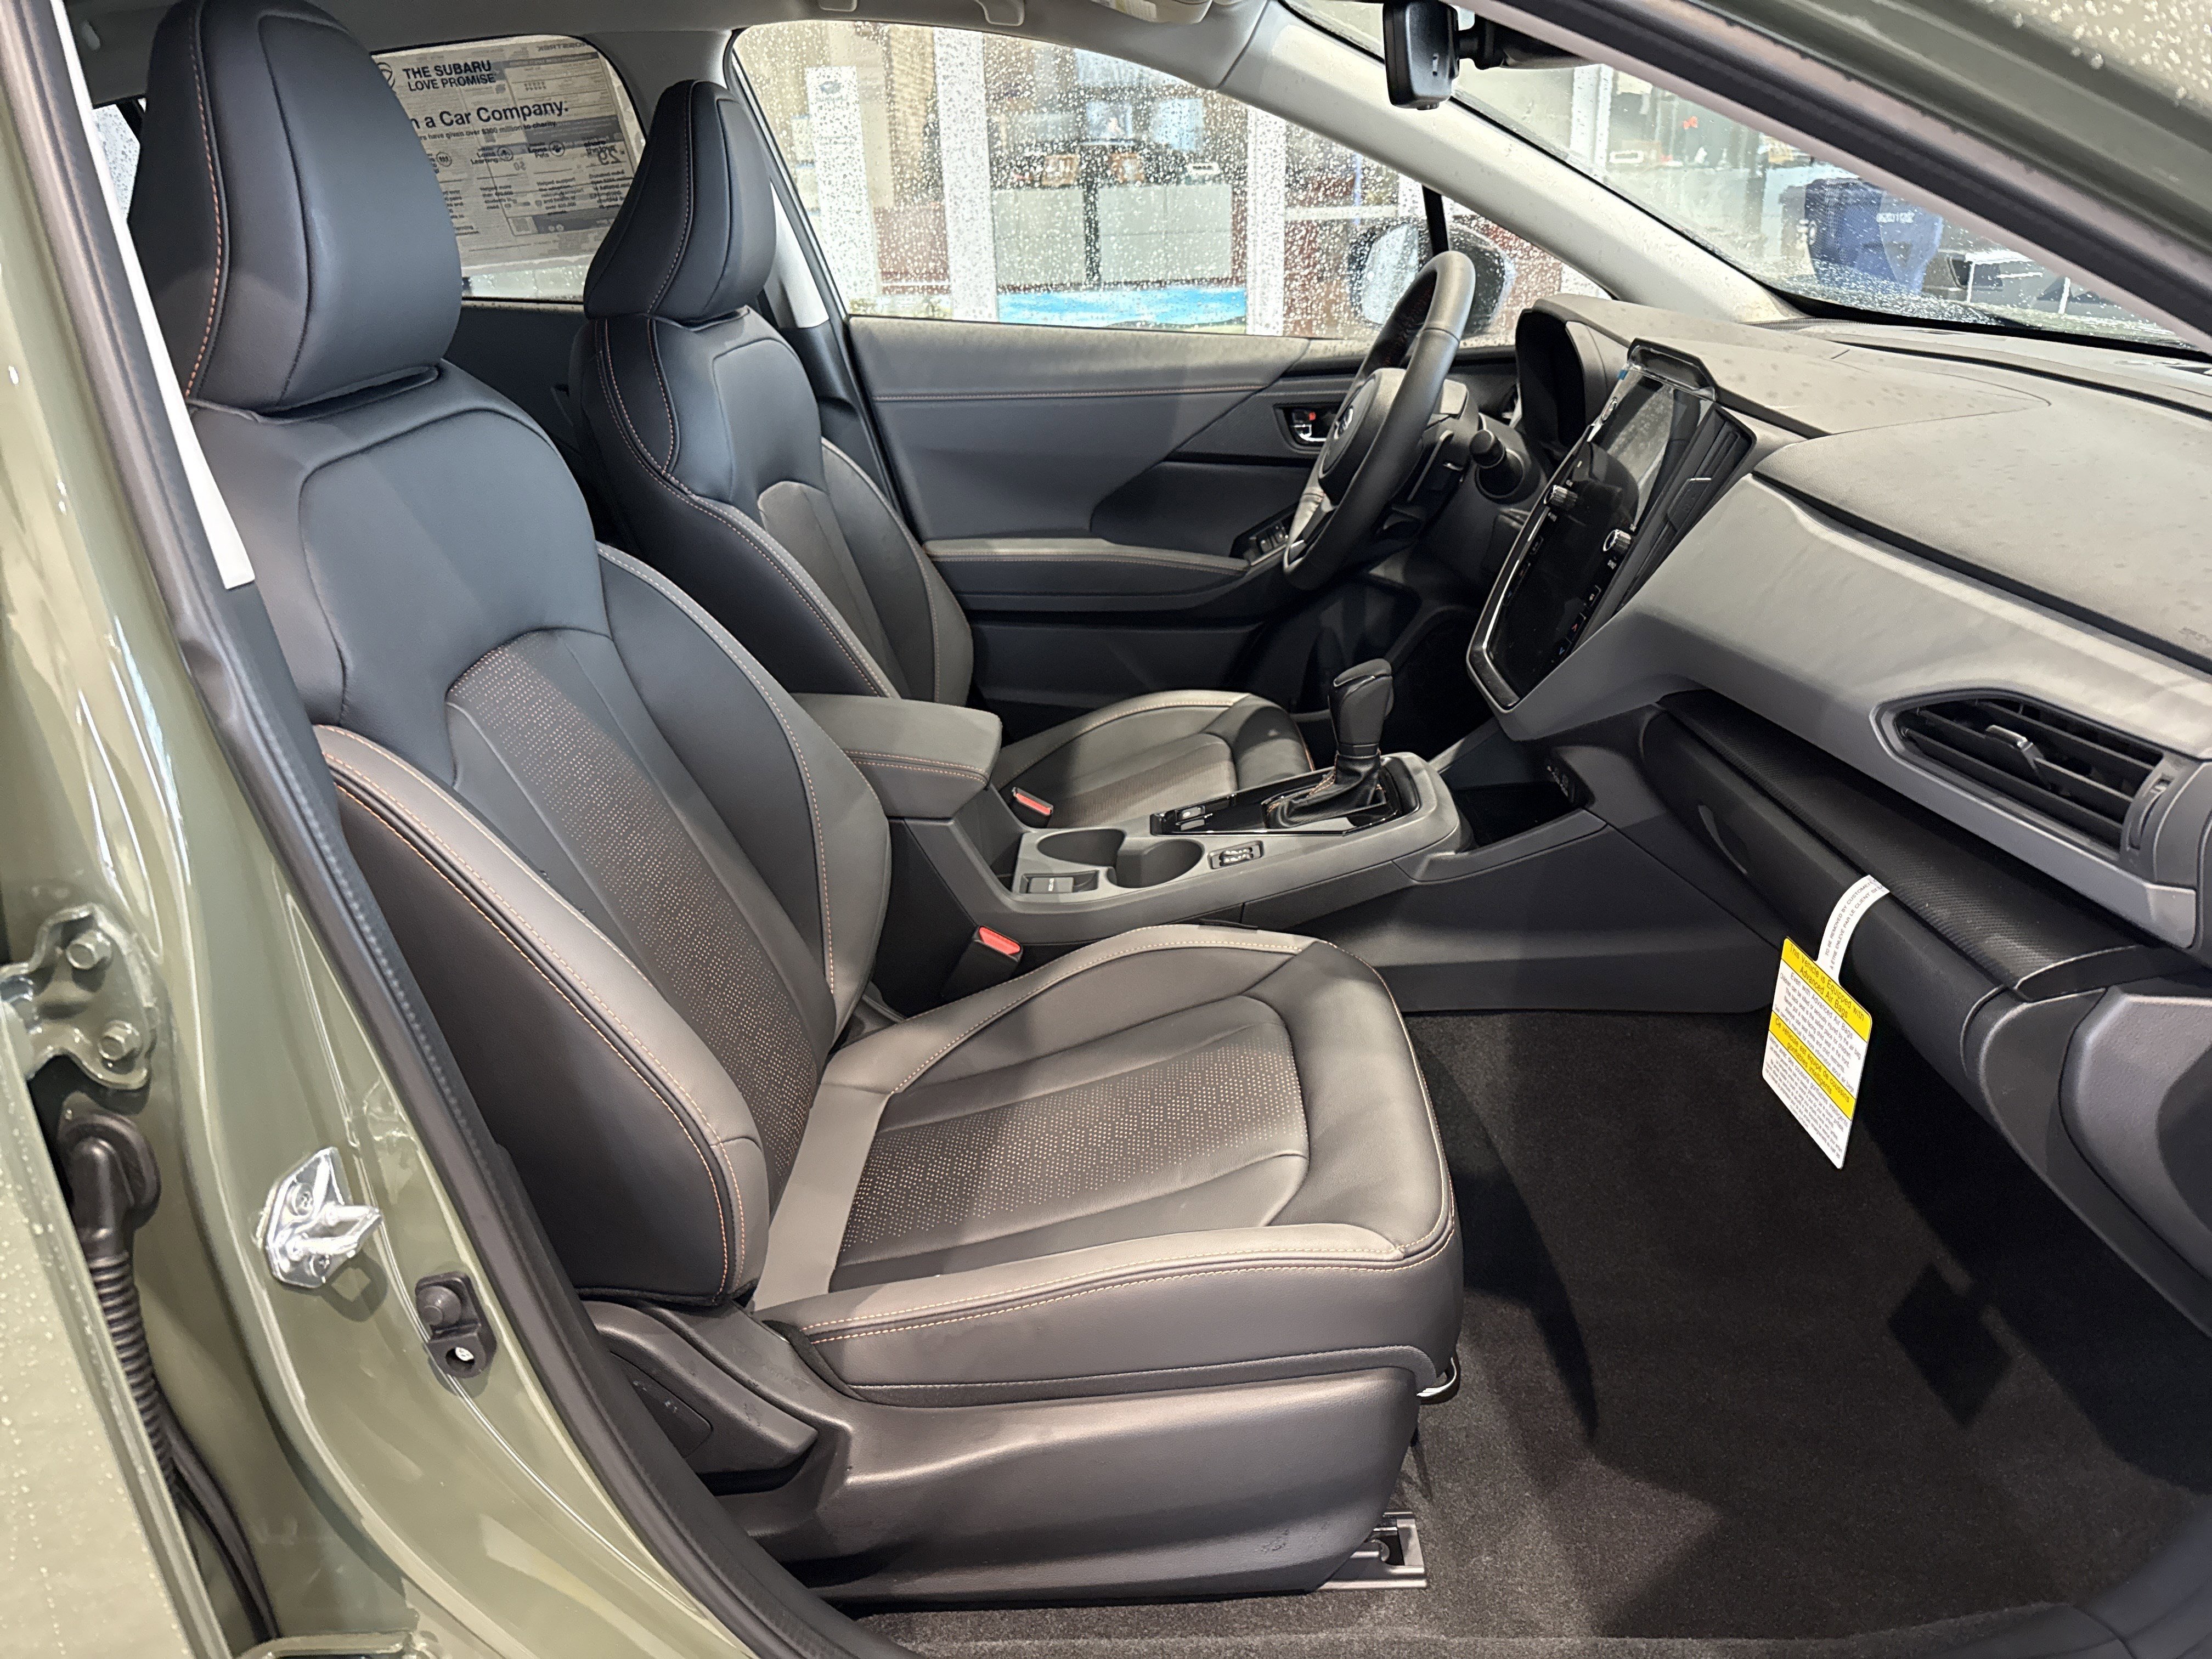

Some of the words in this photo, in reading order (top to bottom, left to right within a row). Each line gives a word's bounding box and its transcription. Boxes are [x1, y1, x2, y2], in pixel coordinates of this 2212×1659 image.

[403, 66, 432, 80] THE
[434, 60, 492, 77] SUBARU
[408, 79, 440, 92] LOVE
[441, 73, 496, 88] PROMISE
[425, 116, 436, 128] a
[439, 111, 471, 126] Car
[476, 101, 569, 122] Company.
[445, 131, 465, 139] given
[1855, 893, 1870, 909] CLIENT
[1825, 948, 1830, 956] TO
[1828, 939, 1832, 947] BE
[1830, 913, 1843, 939] REMOVED
[1841, 905, 1847, 913] BY
[1790, 943, 1800, 960] This
[1802, 954, 1819, 978] Vehicle
[1820, 973, 1826, 984] is
[1826, 978, 1852, 1009] Equipped
[1853, 1006, 1864, 1022] with
[1799, 966, 1825, 995] Advanced
[1825, 991, 1834, 1003] Air
[1833, 998, 1848, 1022] Bags
[1790, 972, 1801, 988] Even
[1802, 984, 1811, 997] with
[1811, 993, 1833, 1019] Advanced
[1841, 1022, 1853, 1040] Bags
[1775, 1017, 1782, 1029] Ce
[1822, 1070, 1829, 1080] de
[1829, 1078, 1850, 1103] coussins
